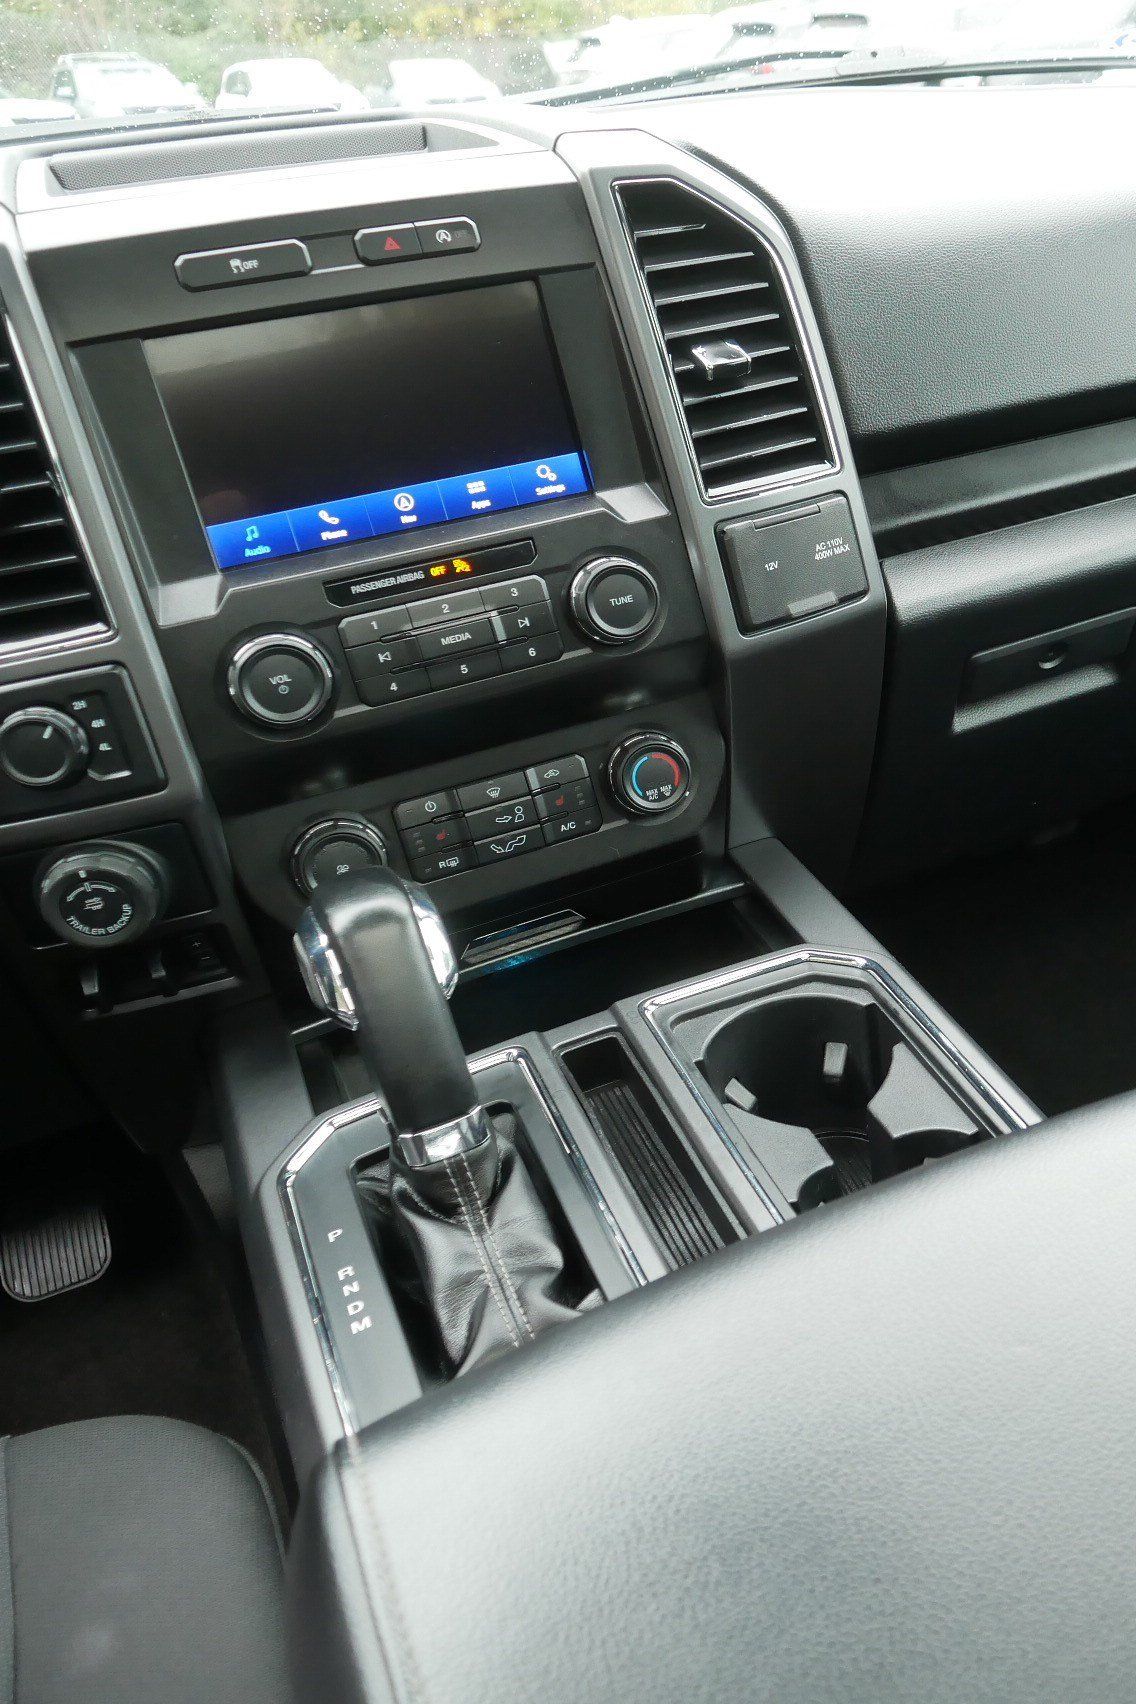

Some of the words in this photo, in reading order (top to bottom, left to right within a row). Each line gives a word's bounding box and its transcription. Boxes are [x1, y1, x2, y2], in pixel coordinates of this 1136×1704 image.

[243, 258, 260, 270] OFF
[535, 483, 566, 496] Settings
[815, 542, 827, 552] AC
[826, 537, 844, 548] 110V
[244, 545, 272, 558] Audio
[814, 549, 834, 561] 400W
[833, 543, 851, 555] MAX
[764, 561, 779, 572] 12V
[350, 578, 397, 595] PASSENGER
[396, 570, 426, 584] AIRBAG
[430, 565, 447, 577] OFF
[510, 587, 519, 598] 3
[609, 594, 634, 607] TUNE
[441, 604, 450, 614] 2
[370, 620, 379, 630] 1
[440, 631, 473, 646] MEDIA
[528, 647, 537, 658] 6
[460, 664, 469, 675] 5
[268, 674, 293, 685] VOL
[390, 682, 398, 692] 4
[560, 821, 577, 833] A/C
[65, 915, 106, 936] TRAILER
[108, 903, 133, 934] BACKUP
[327, 1228, 343, 1243] P
[337, 1265, 356, 1281] R
[342, 1281, 360, 1297] N
[346, 1300, 365, 1316] D
[350, 1315, 373, 1335] M
